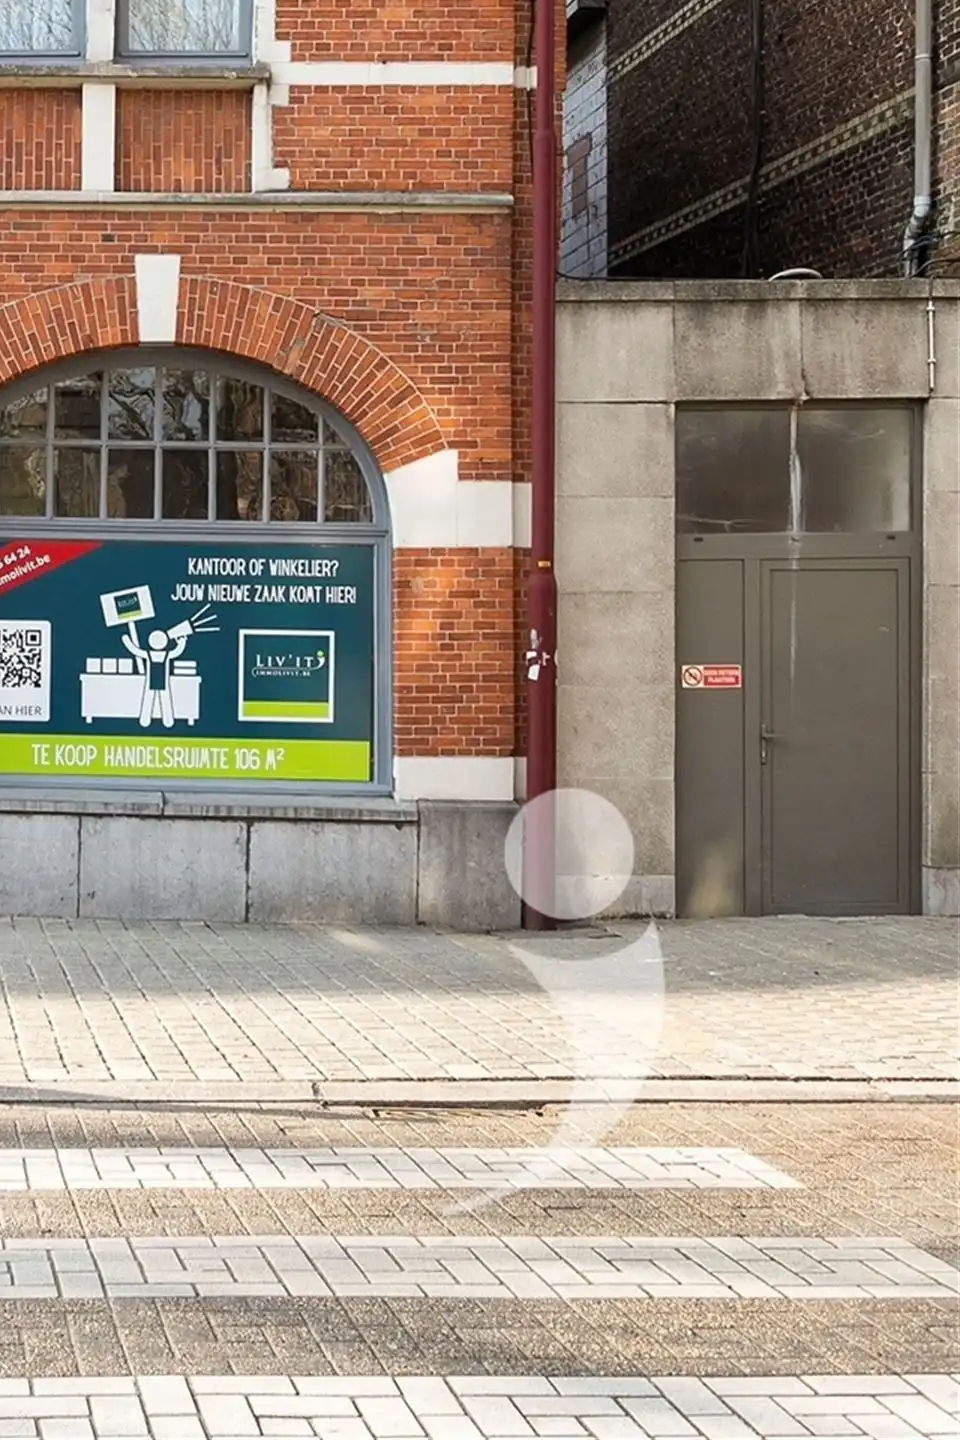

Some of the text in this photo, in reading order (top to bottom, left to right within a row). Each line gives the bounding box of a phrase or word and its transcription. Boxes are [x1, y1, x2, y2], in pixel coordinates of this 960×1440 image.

[3, 552, 17, 565] 64
[16, 545, 31, 559] 24
[188, 557, 339, 577] KANTOOR OF WINKELIER?
[171, 583, 357, 604] JOUW NIEUWE ZAAK KOMT HIER!
[15, 704, 42, 716] HIER
[31, 743, 50, 765] TE
[55, 744, 97, 767] KOOP
[103, 745, 229, 769] HANDELSRUIMTE
[234, 747, 261, 770] 106
